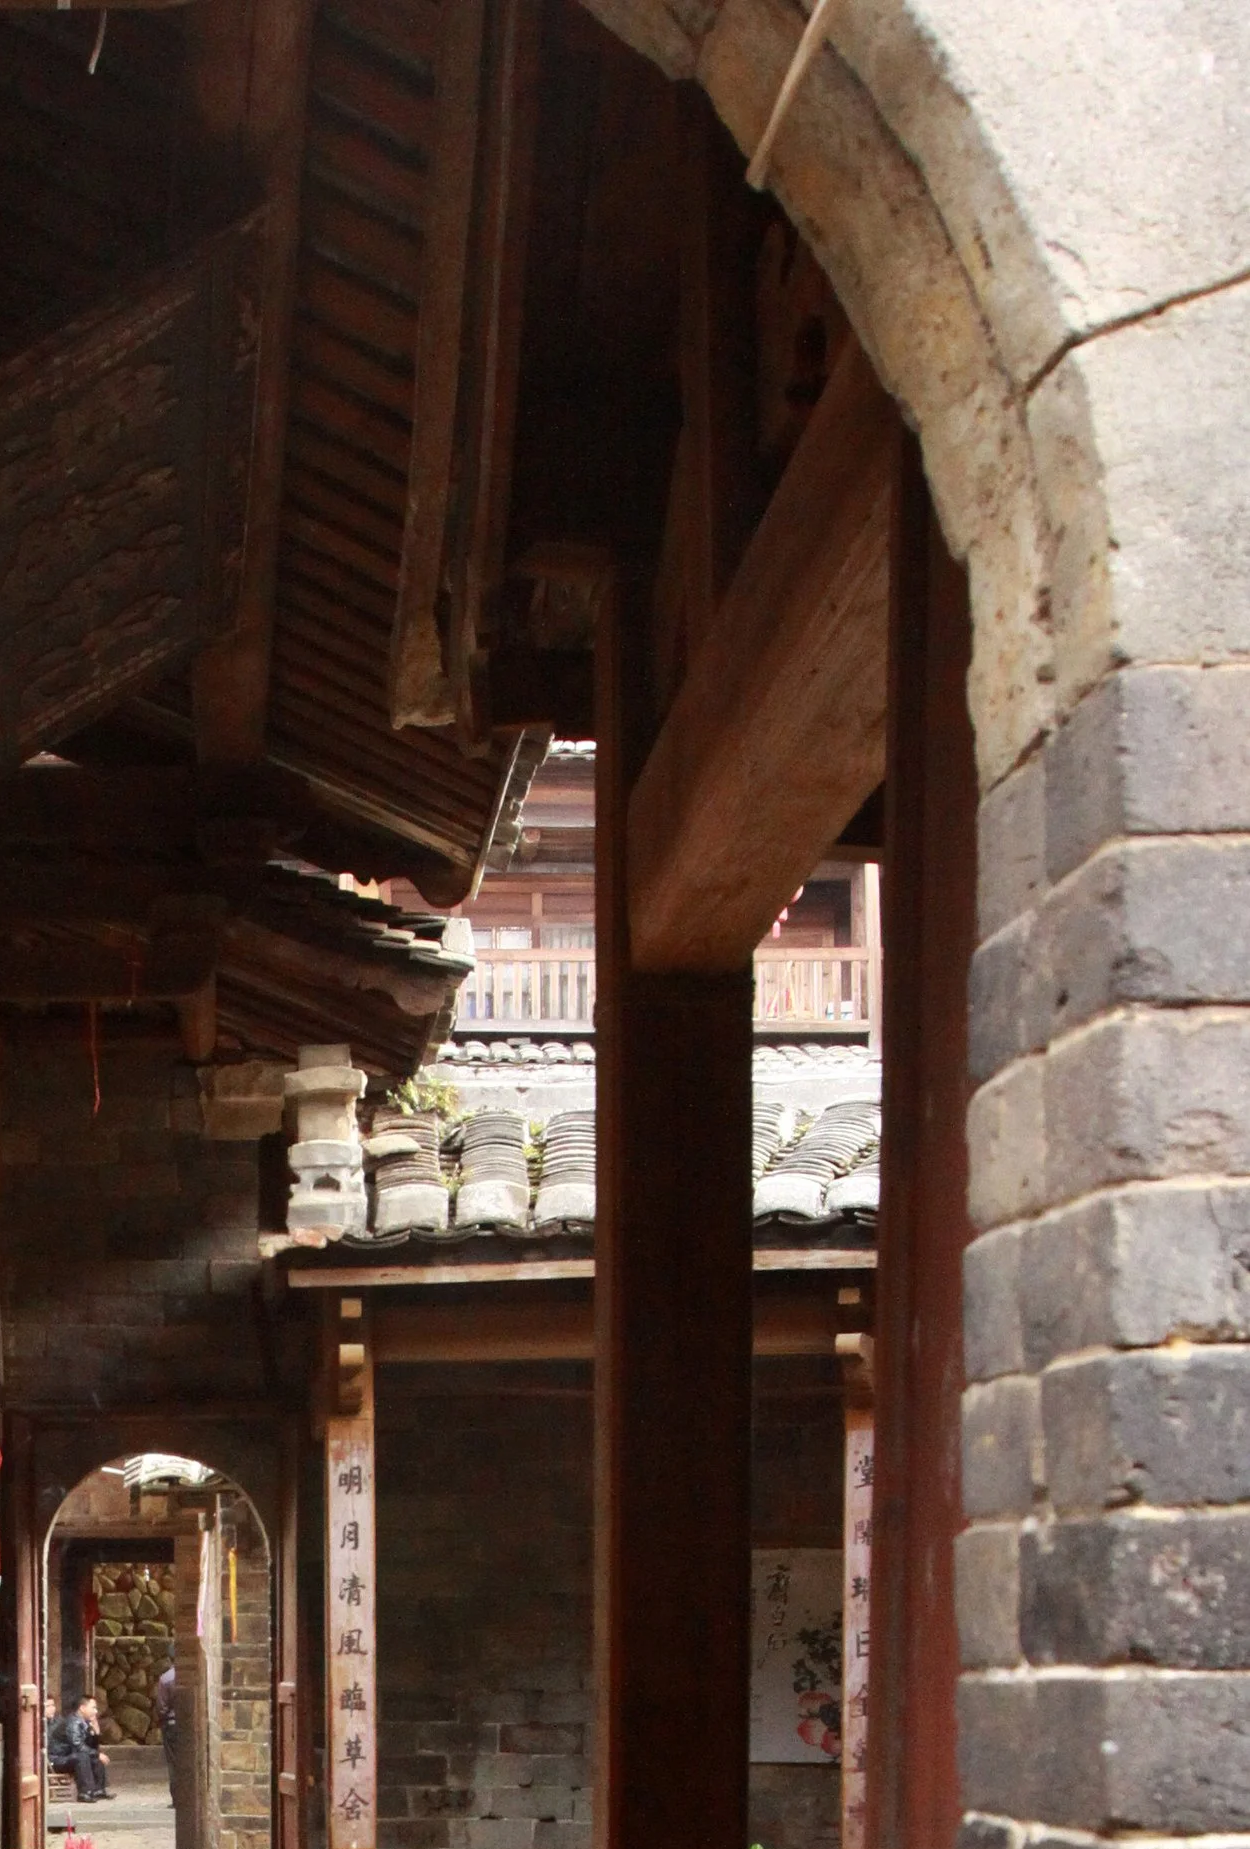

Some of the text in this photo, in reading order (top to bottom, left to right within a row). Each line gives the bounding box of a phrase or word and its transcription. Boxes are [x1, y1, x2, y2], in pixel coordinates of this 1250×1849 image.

[337, 1465, 369, 1821] 明月清風臨草舍
